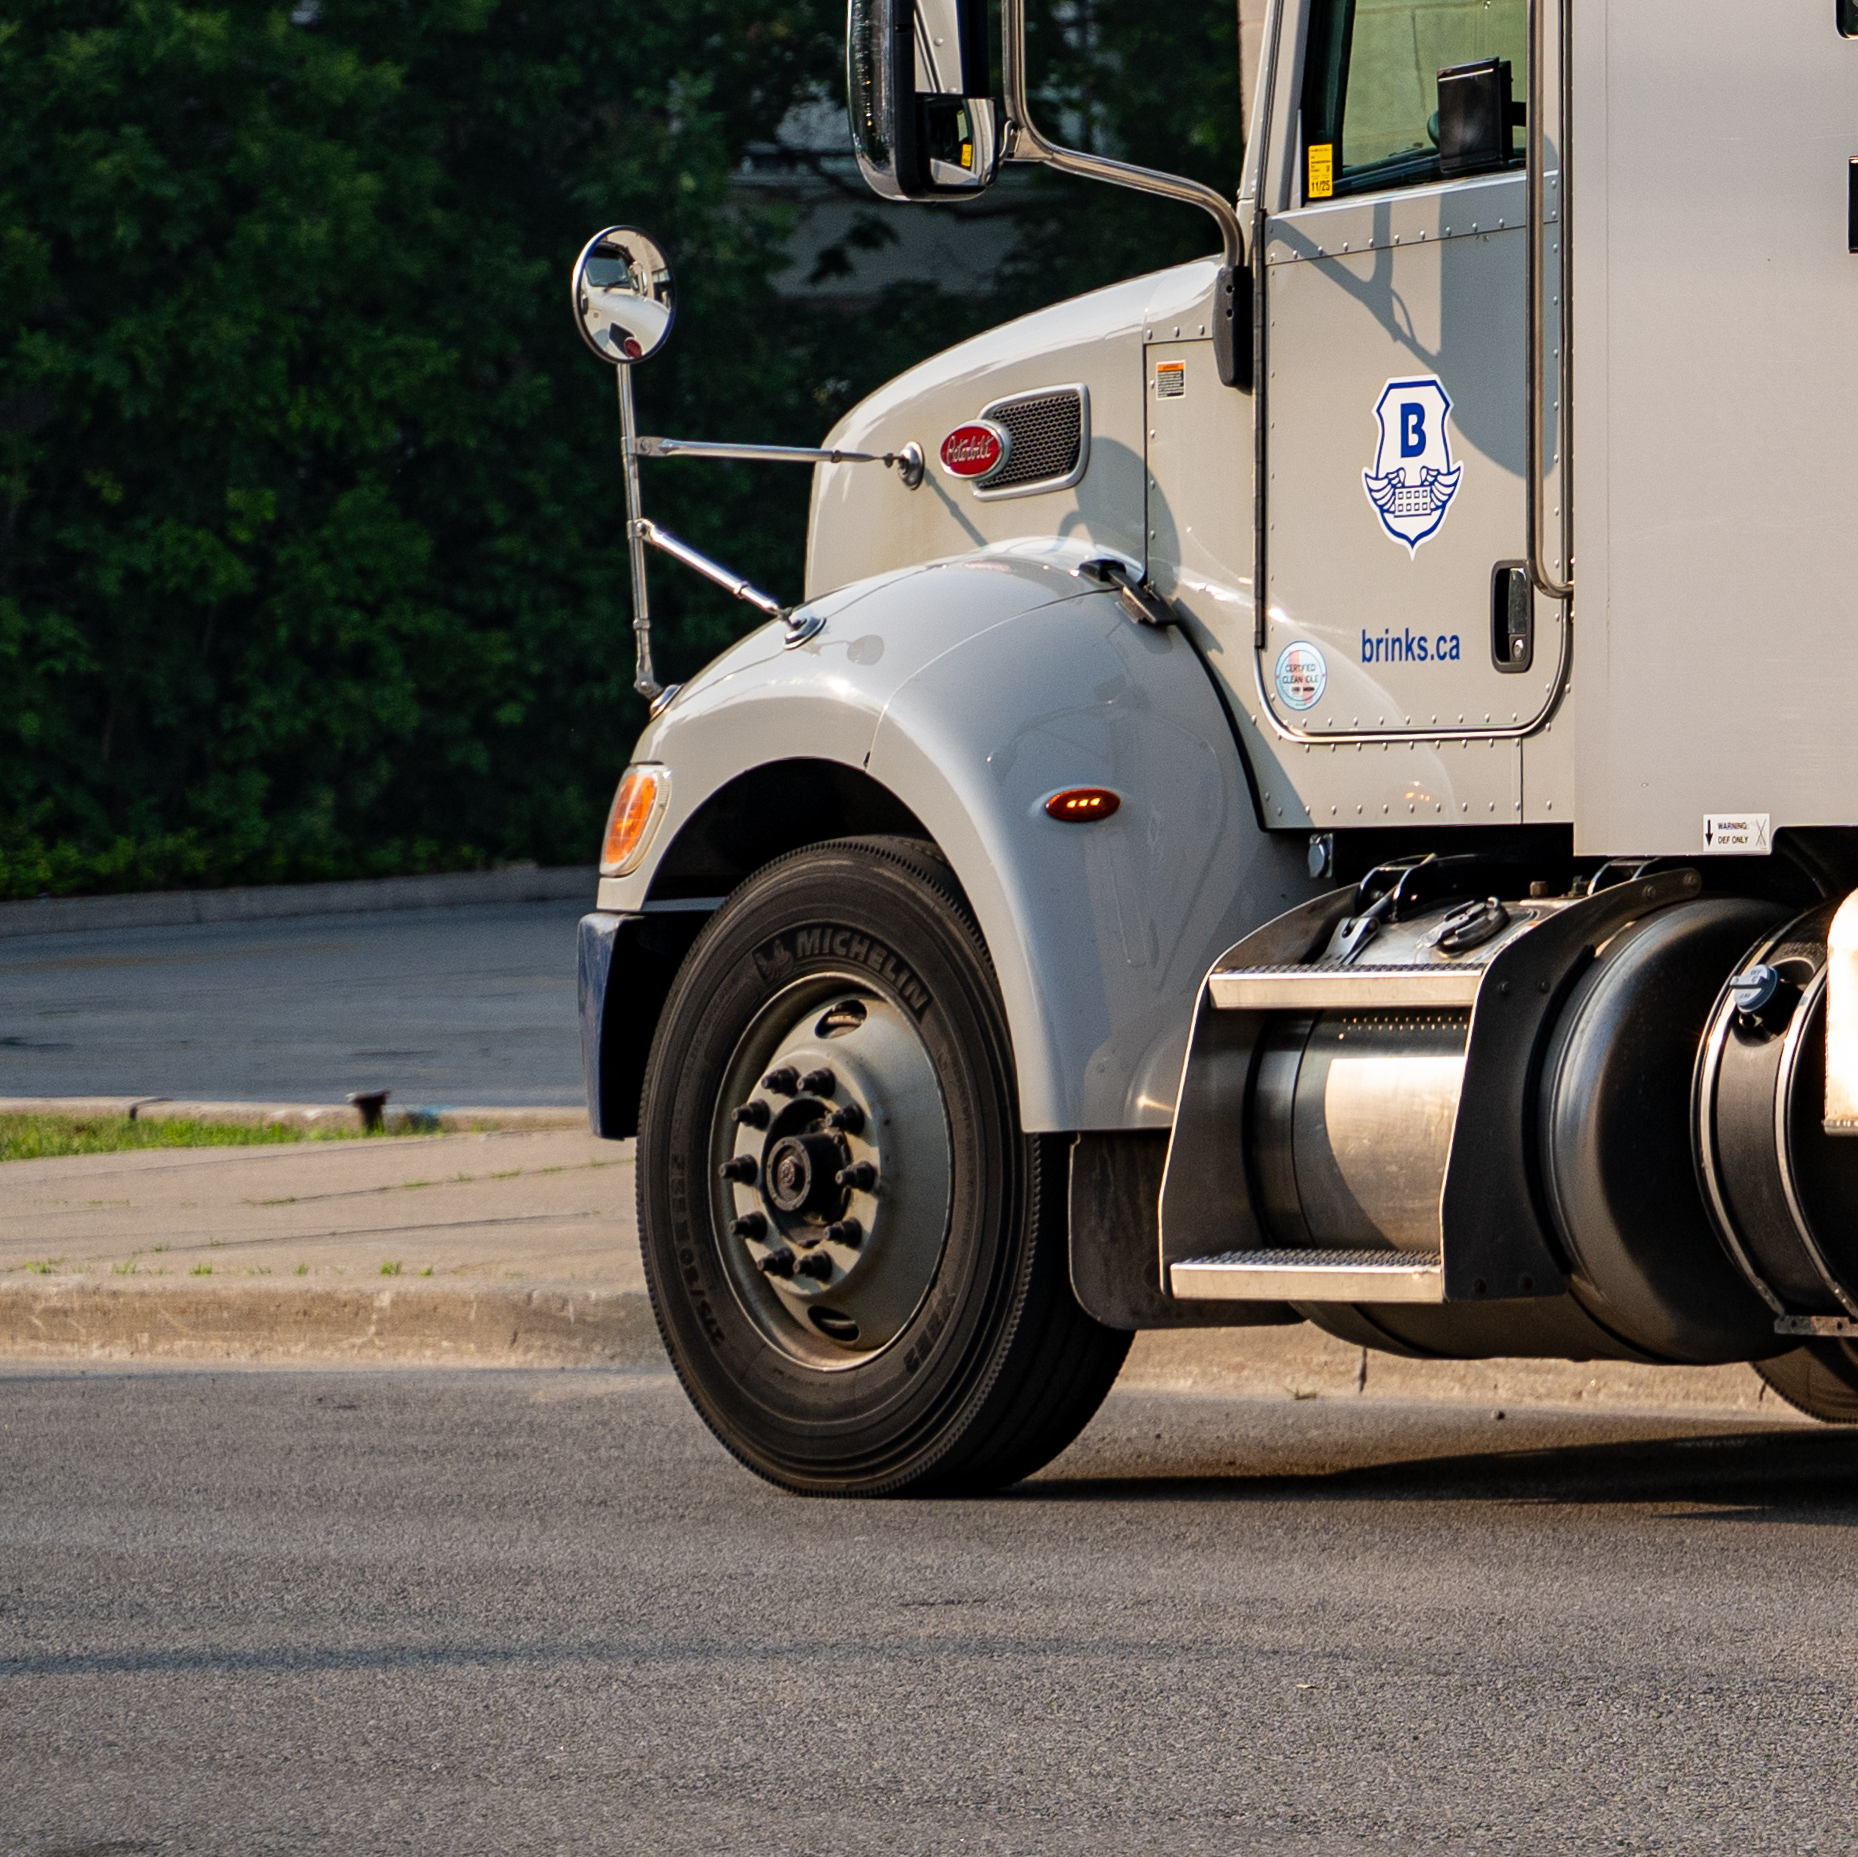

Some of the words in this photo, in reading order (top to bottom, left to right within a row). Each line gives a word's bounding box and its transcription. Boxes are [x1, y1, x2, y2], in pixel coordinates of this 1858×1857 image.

[1311, 180, 1330, 192] 11/25
[1399, 402, 1427, 459] B
[1360, 627, 1461, 663] brinks.ca
[796, 927, 930, 1010] MICHELIN
